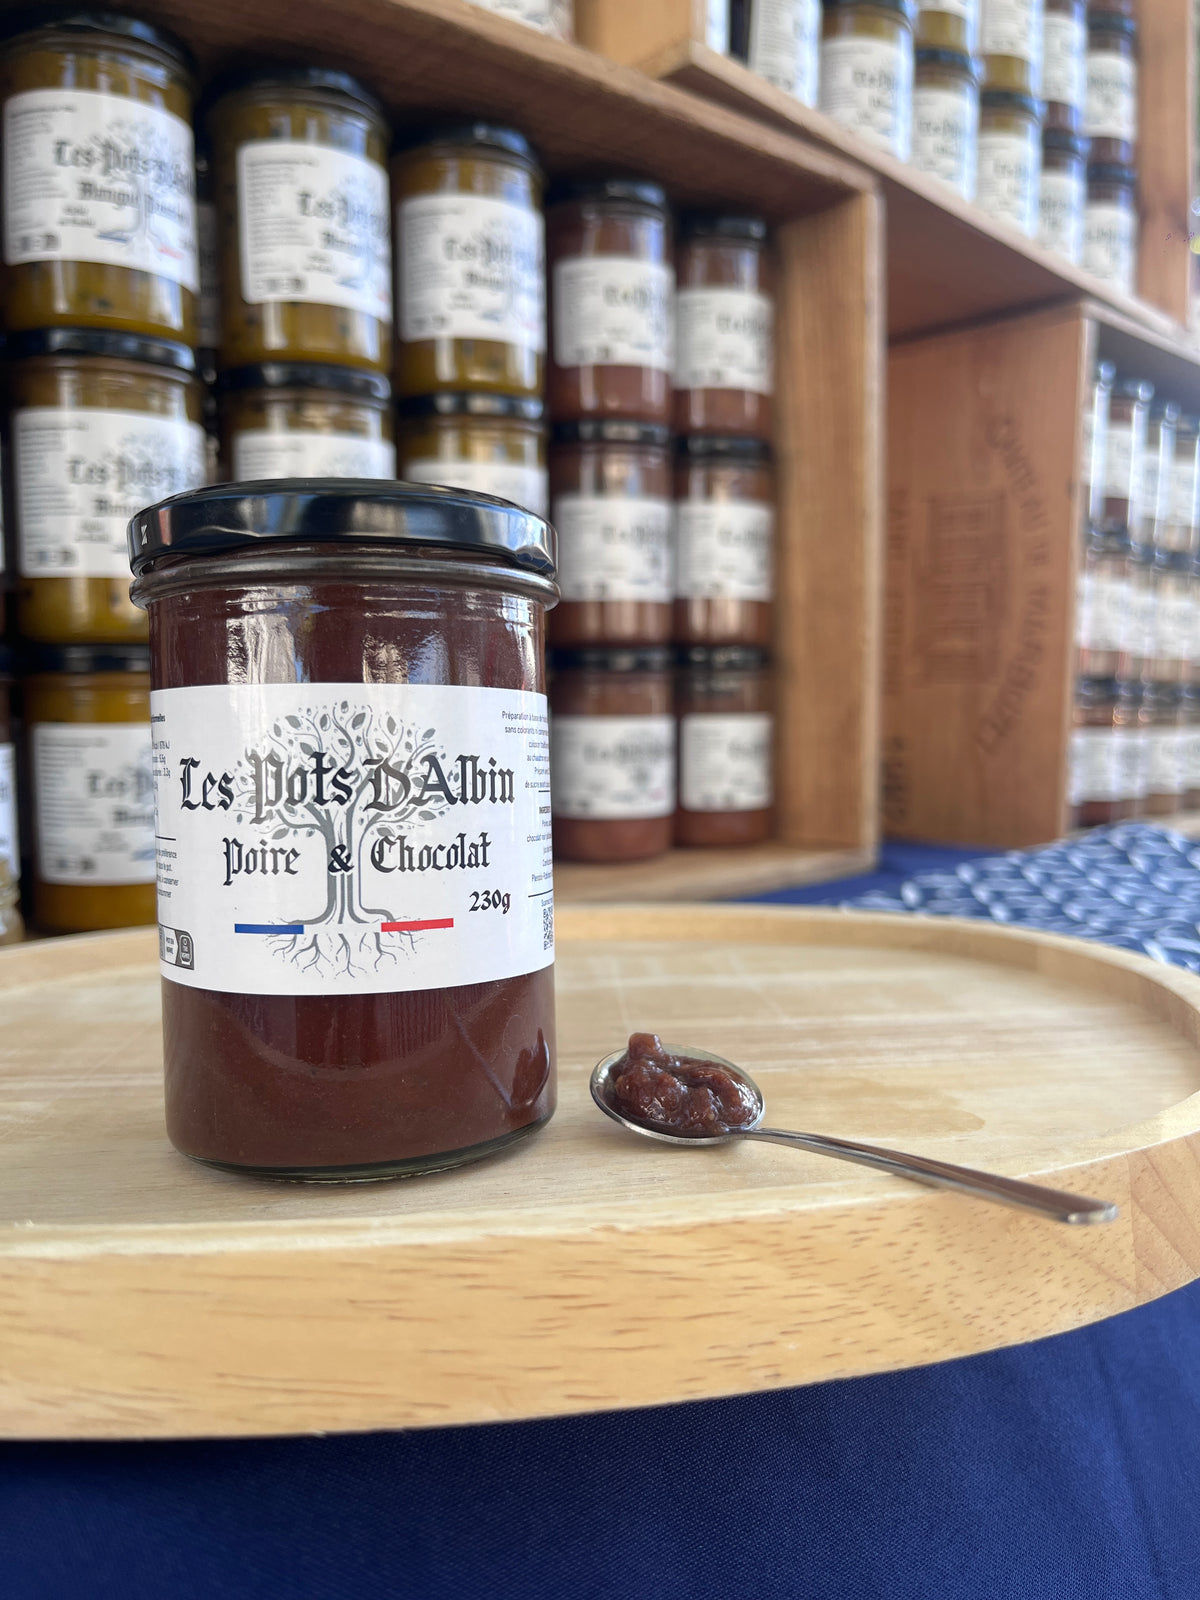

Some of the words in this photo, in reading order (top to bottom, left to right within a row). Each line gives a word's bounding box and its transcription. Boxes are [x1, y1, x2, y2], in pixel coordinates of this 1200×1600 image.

[180, 757, 235, 811] Les
[248, 750, 354, 825] Pots
[222, 837, 301, 886] Poire
[327, 844, 355, 873] &
[370, 831, 492, 873] Chocolat
[468, 888, 511, 915] 230g
